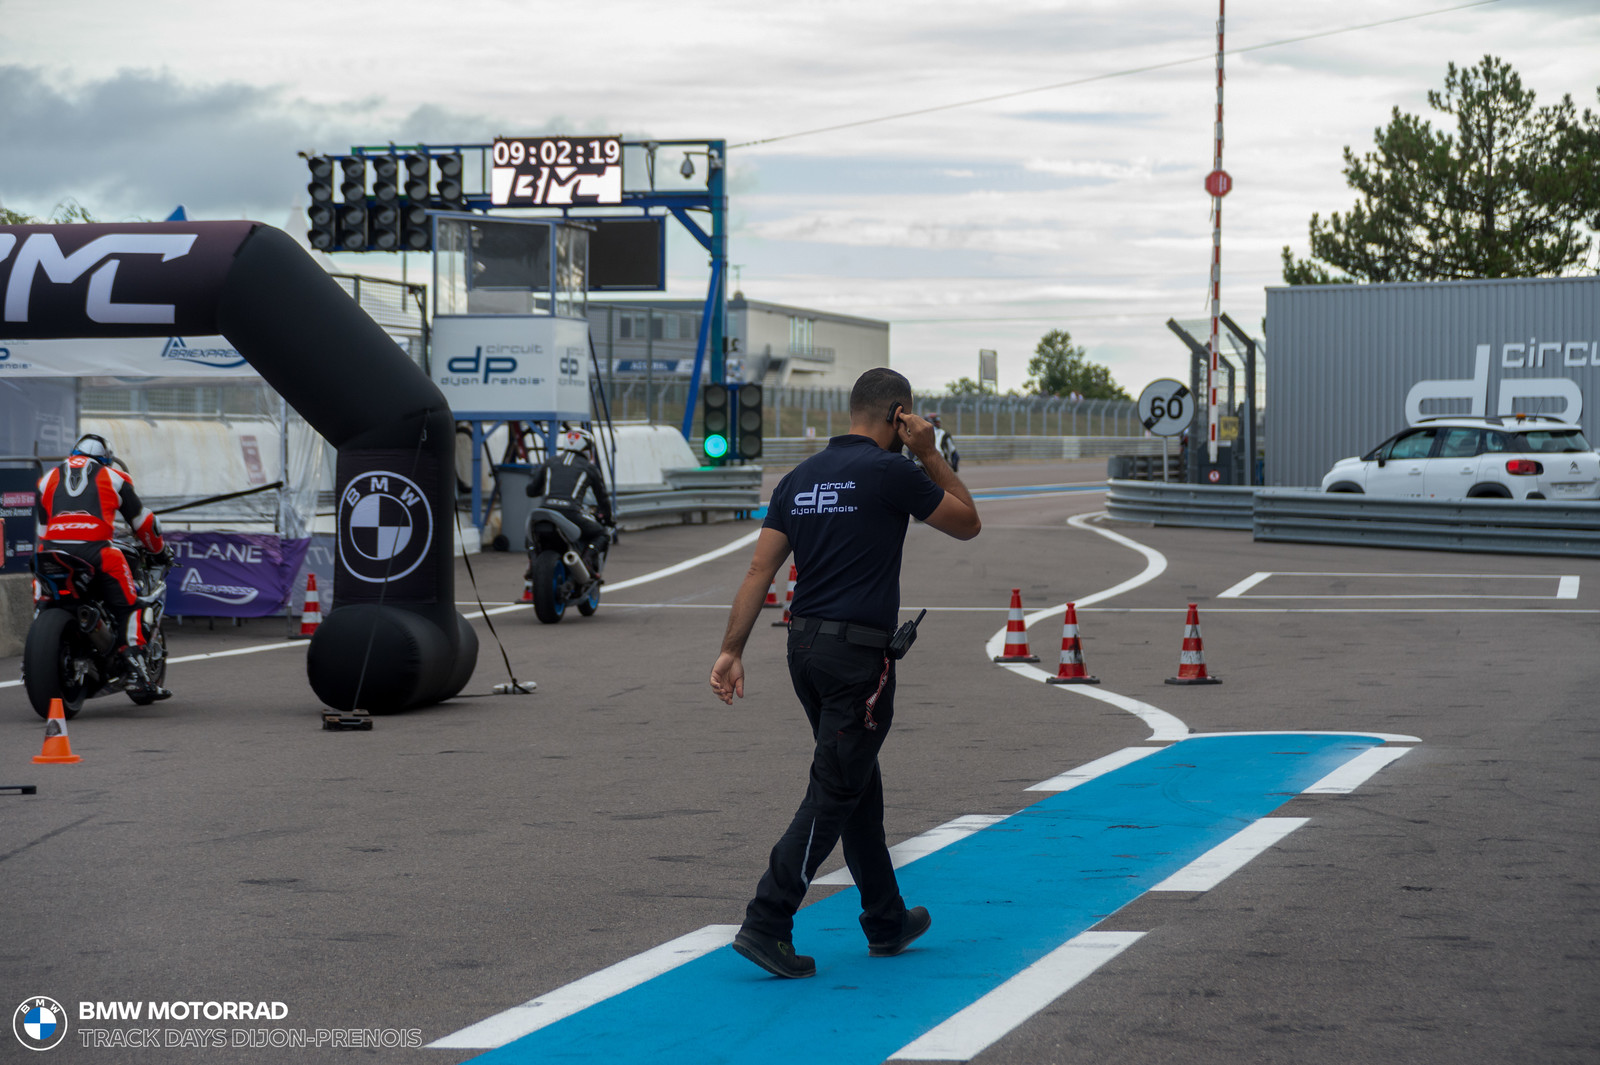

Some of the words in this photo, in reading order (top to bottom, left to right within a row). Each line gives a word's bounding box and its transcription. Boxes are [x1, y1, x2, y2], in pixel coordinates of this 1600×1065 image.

[493, 140, 620, 165] 09:02:19
[161, 336, 242, 358] ABRIEXPRES
[485, 343, 544, 354] circuit
[1150, 396, 1183, 420] 60
[345, 476, 421, 508] BMW
[820, 480, 856, 490] circuit
[791, 508, 816, 516] dijon
[165, 541, 262, 563] TLANE
